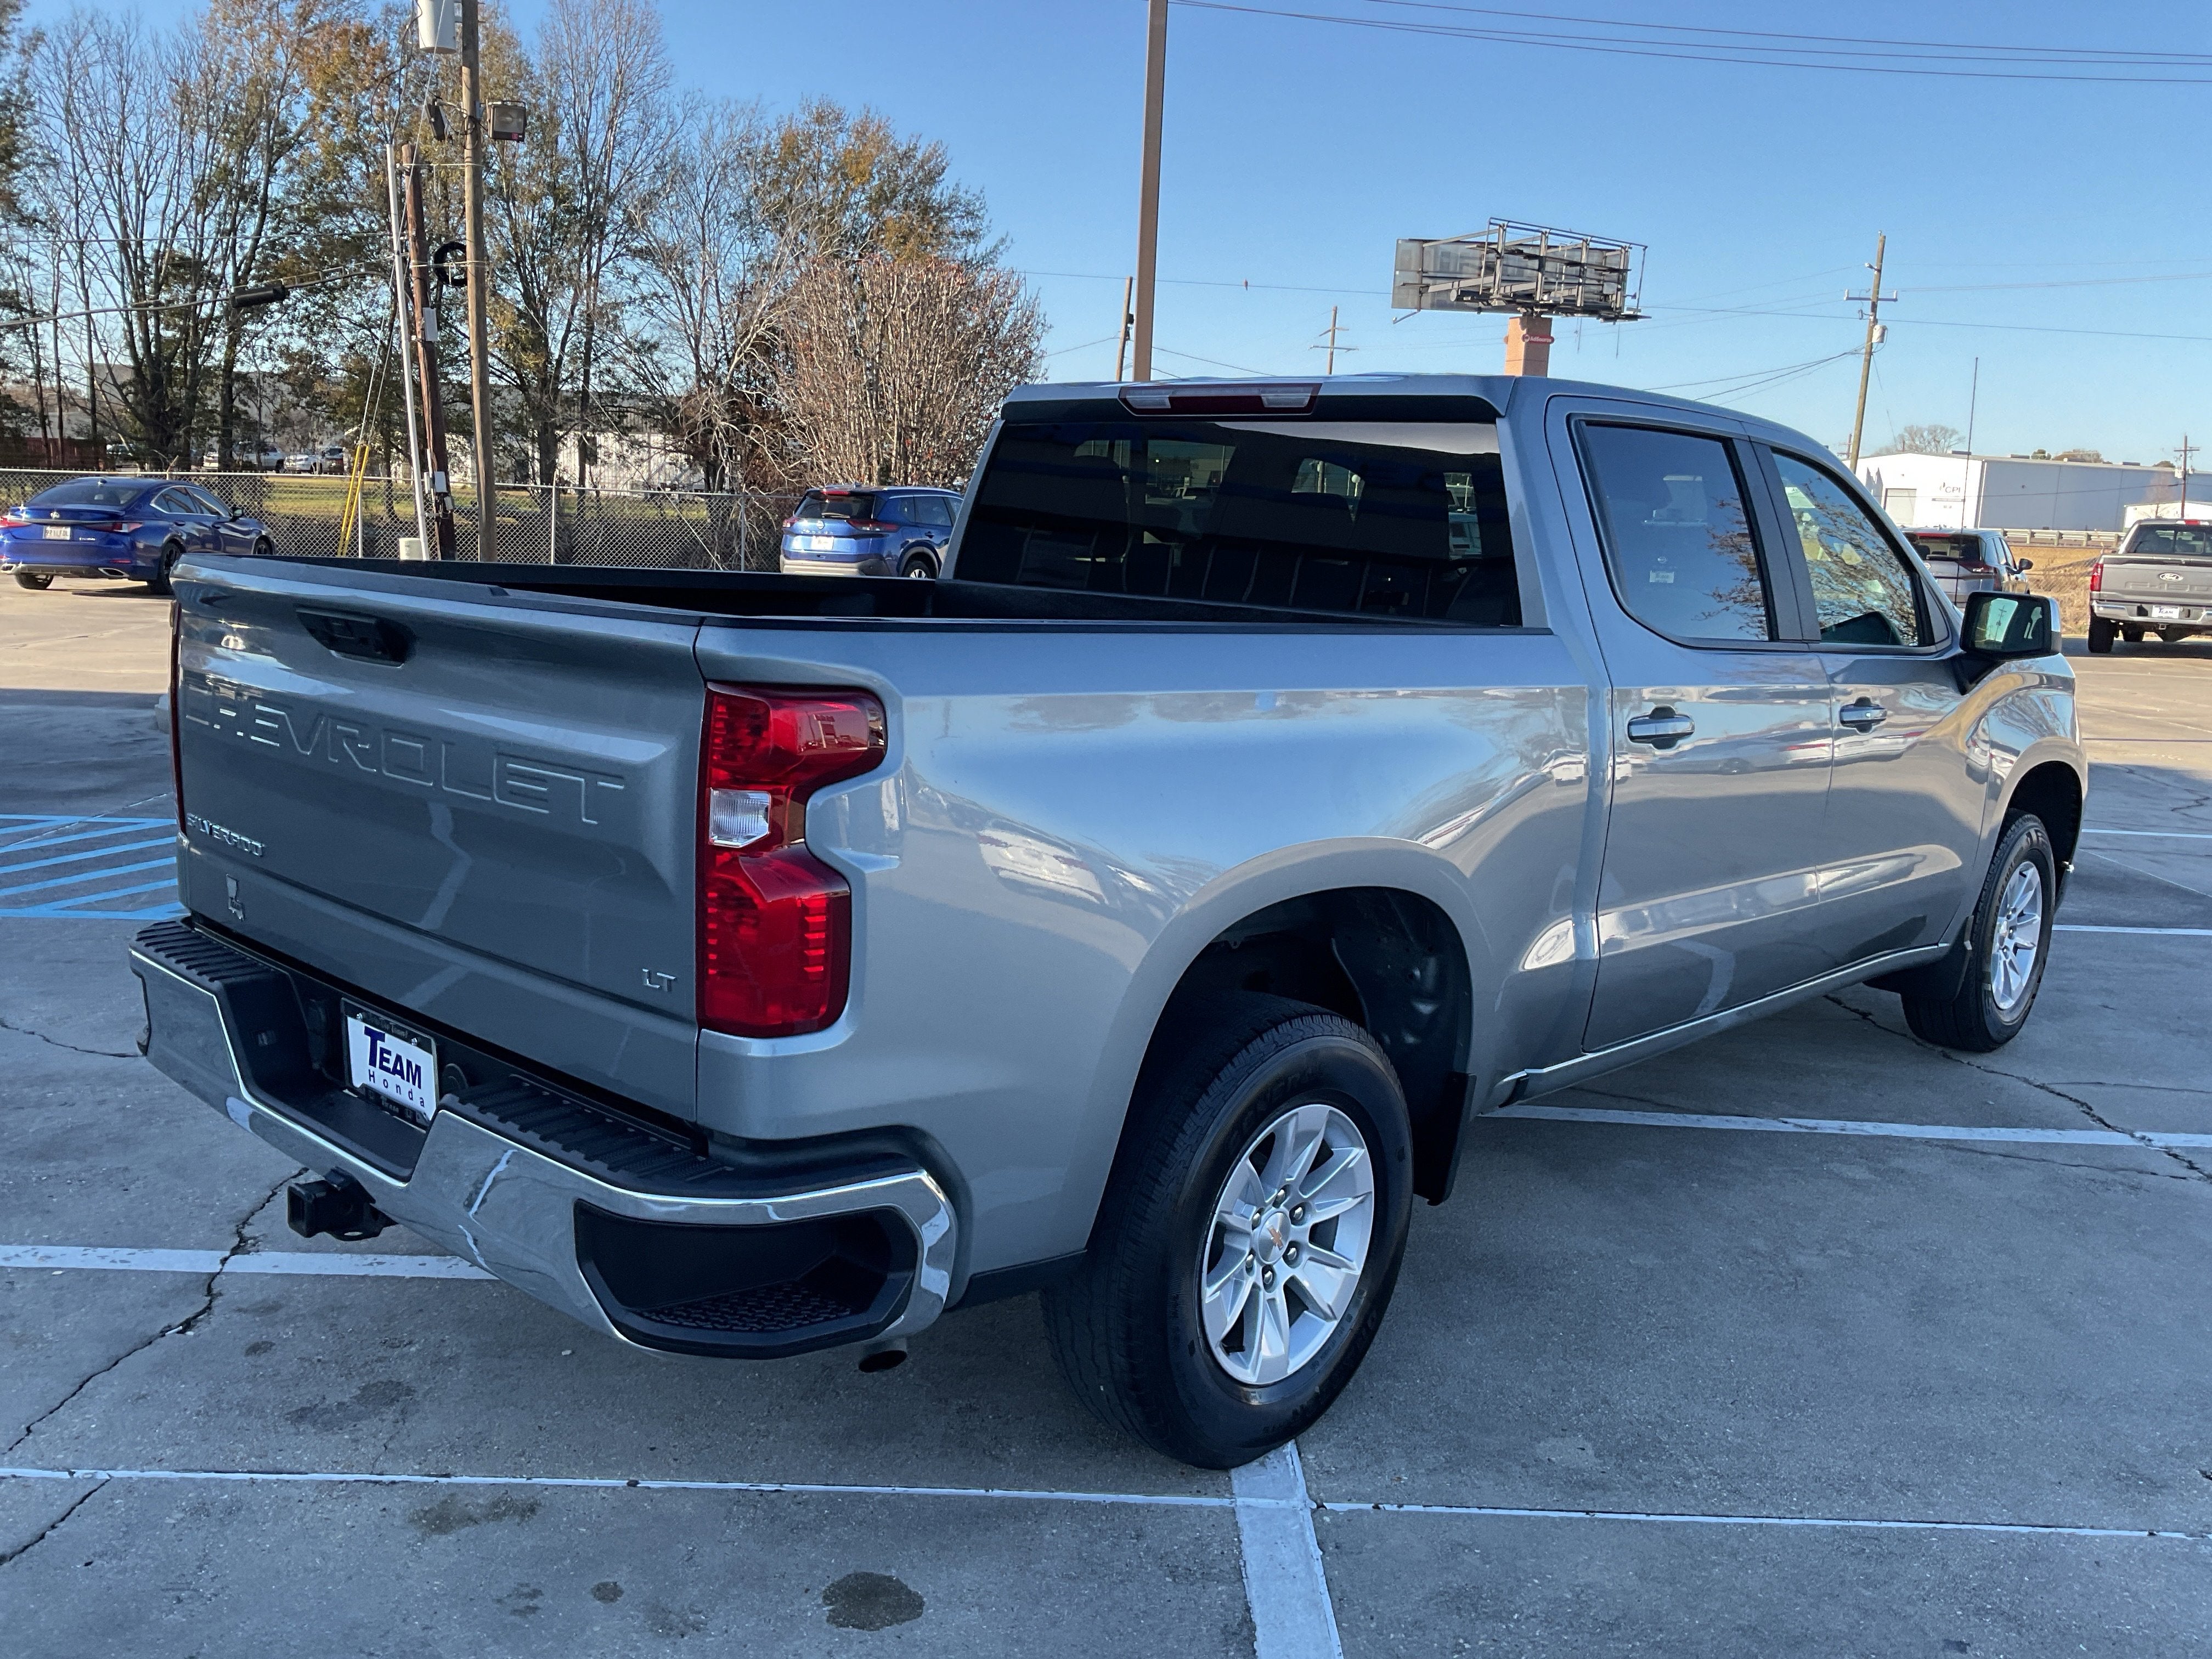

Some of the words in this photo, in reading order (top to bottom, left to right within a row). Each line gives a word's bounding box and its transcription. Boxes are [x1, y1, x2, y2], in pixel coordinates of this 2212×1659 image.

[642, 968, 677, 992] LT
[364, 1025, 422, 1090] TEAM
[368, 1069, 425, 1108] Honda
